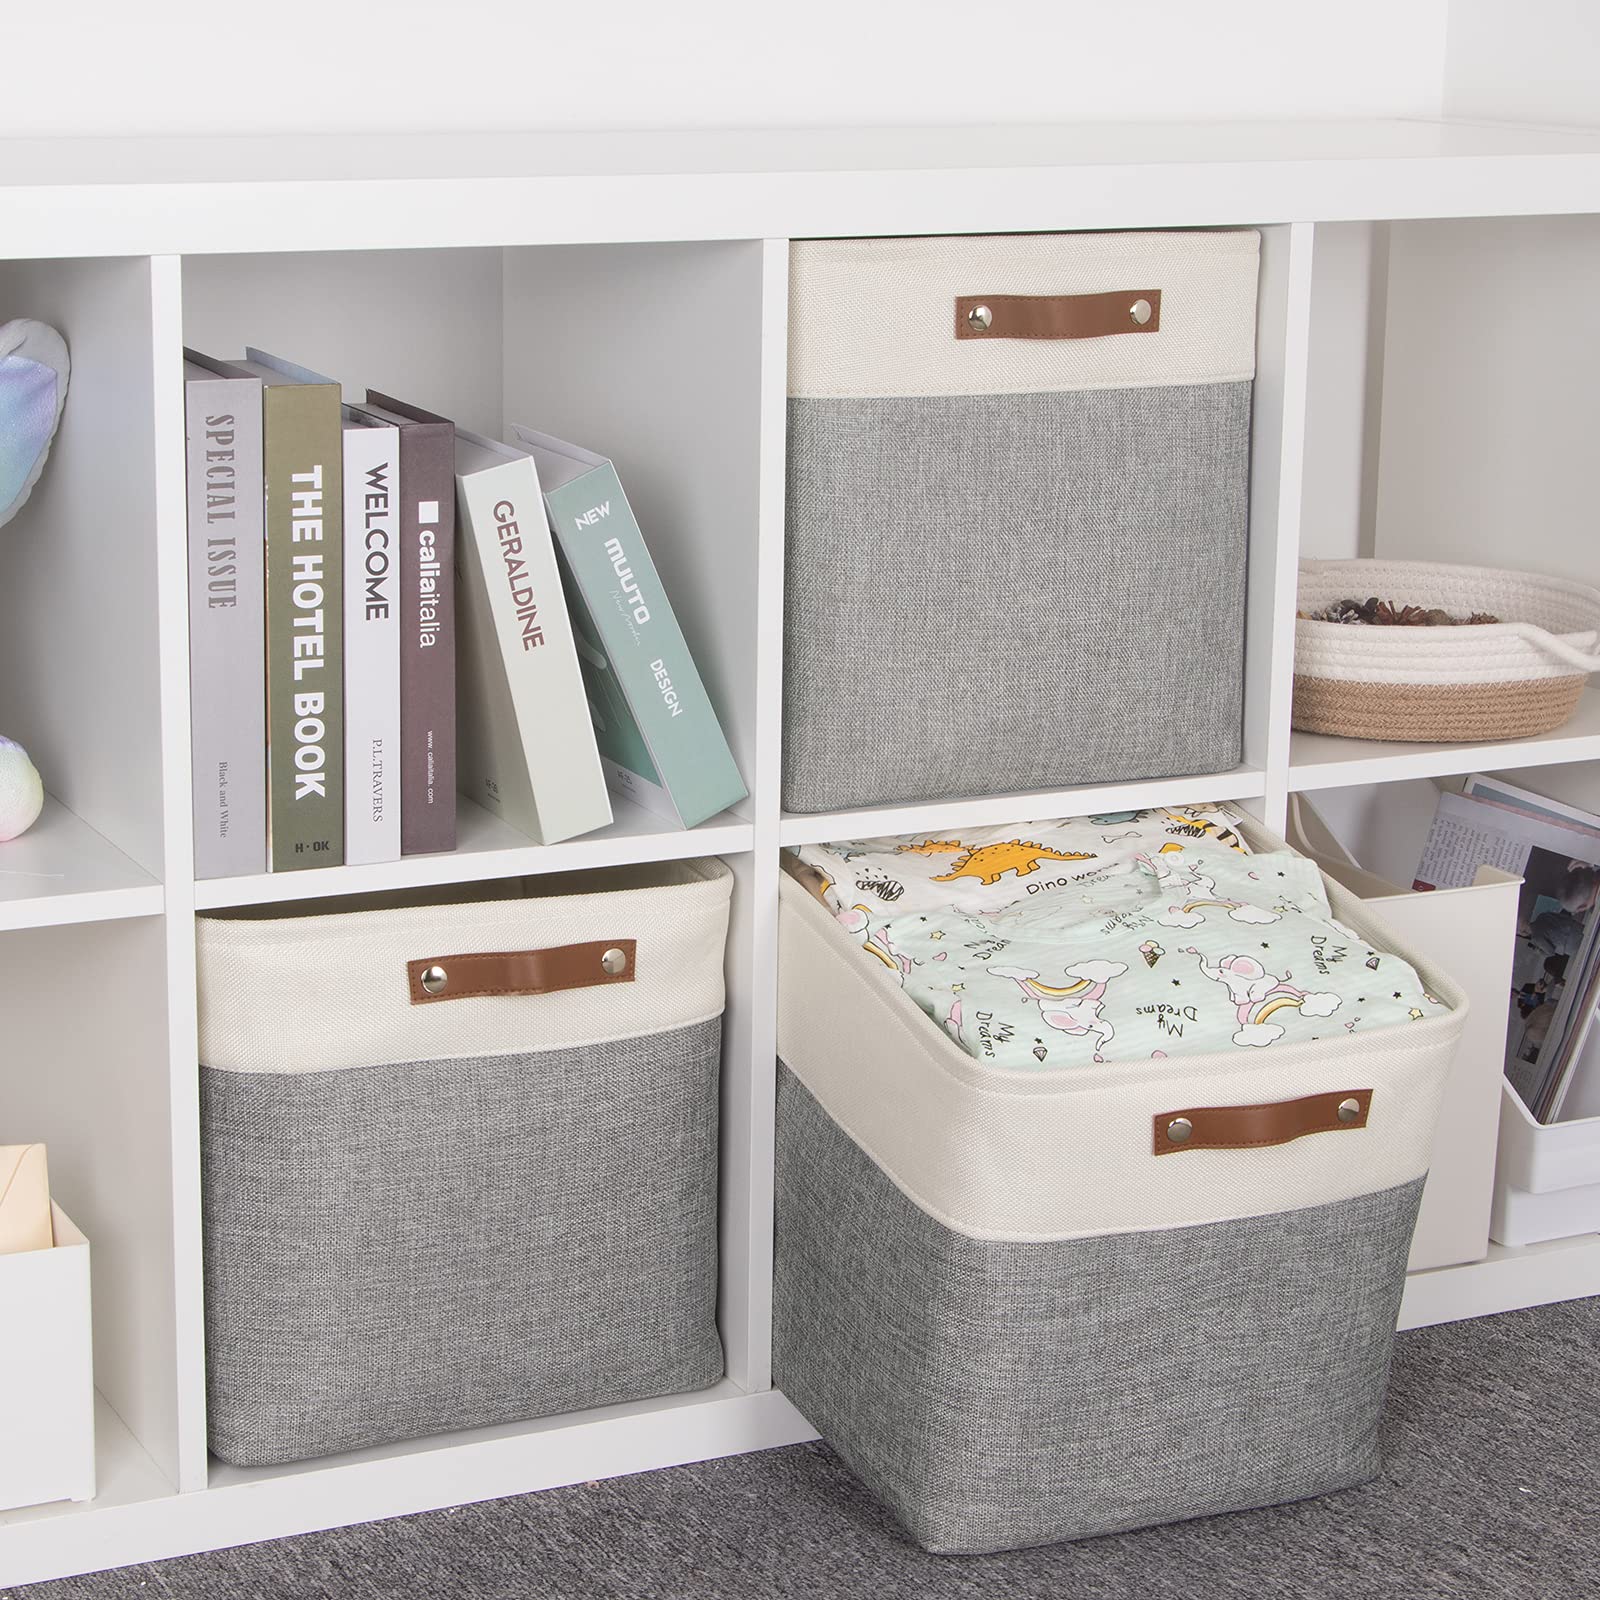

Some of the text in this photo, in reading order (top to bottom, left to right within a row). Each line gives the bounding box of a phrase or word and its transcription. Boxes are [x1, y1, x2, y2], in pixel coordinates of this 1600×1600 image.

[205, 414, 237, 608] SPECIAL ISSUE
[574, 501, 611, 530] NEW
[364, 462, 390, 621] WELCOME
[418, 530, 441, 649] caliaitalia
[493, 500, 545, 651] GERALDINE
[291, 465, 326, 801] THE HOTEL BOOK
[650, 658, 683, 717] DESIGN
[218, 761, 230, 838] Black and White
[1026, 877, 1068, 895] Dino
[1310, 935, 1330, 975] Dreams
[1325, 945, 1348, 963] My
[975, 1011, 996, 1058] Dreams
[992, 1022, 1015, 1044] My
[1135, 1003, 1198, 1022] Dreams
[1157, 1013, 1184, 1038] My
